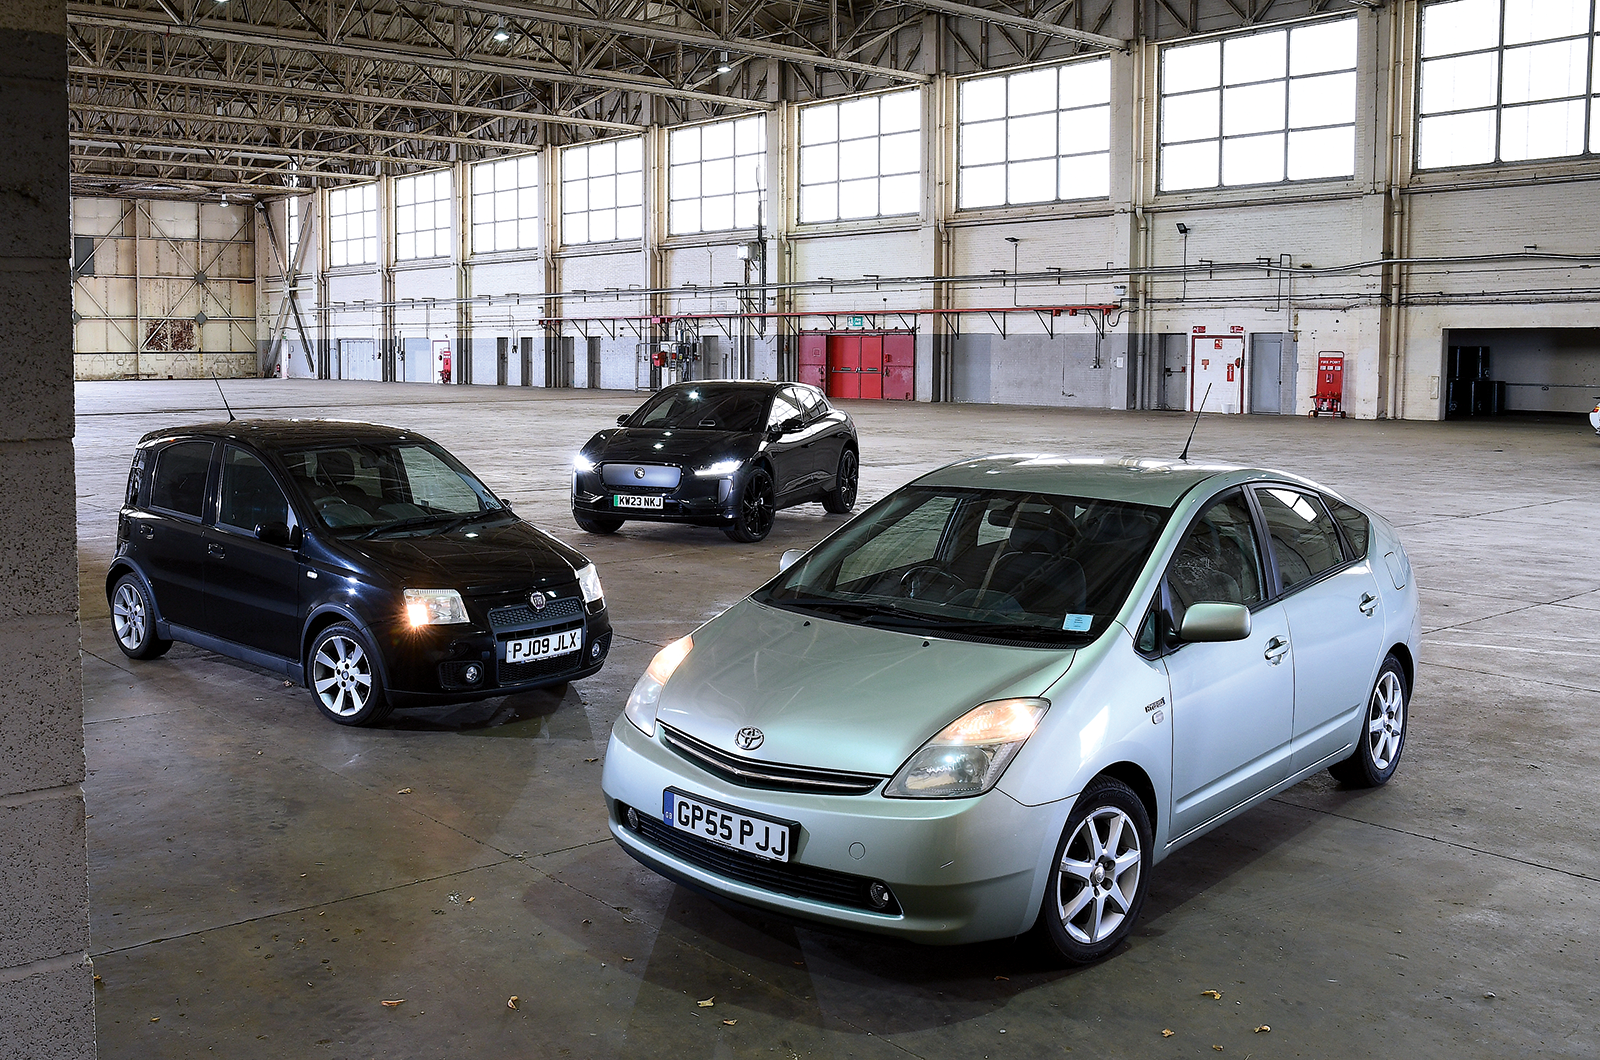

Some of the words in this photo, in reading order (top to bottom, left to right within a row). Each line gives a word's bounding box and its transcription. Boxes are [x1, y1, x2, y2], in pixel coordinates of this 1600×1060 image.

[619, 496, 642, 506] KW23
[643, 497, 662, 507] NKJ
[513, 637, 550, 659] PJ09
[553, 631, 577, 652] JLX
[677, 800, 733, 841] GP55
[739, 819, 786, 856] PJJ
